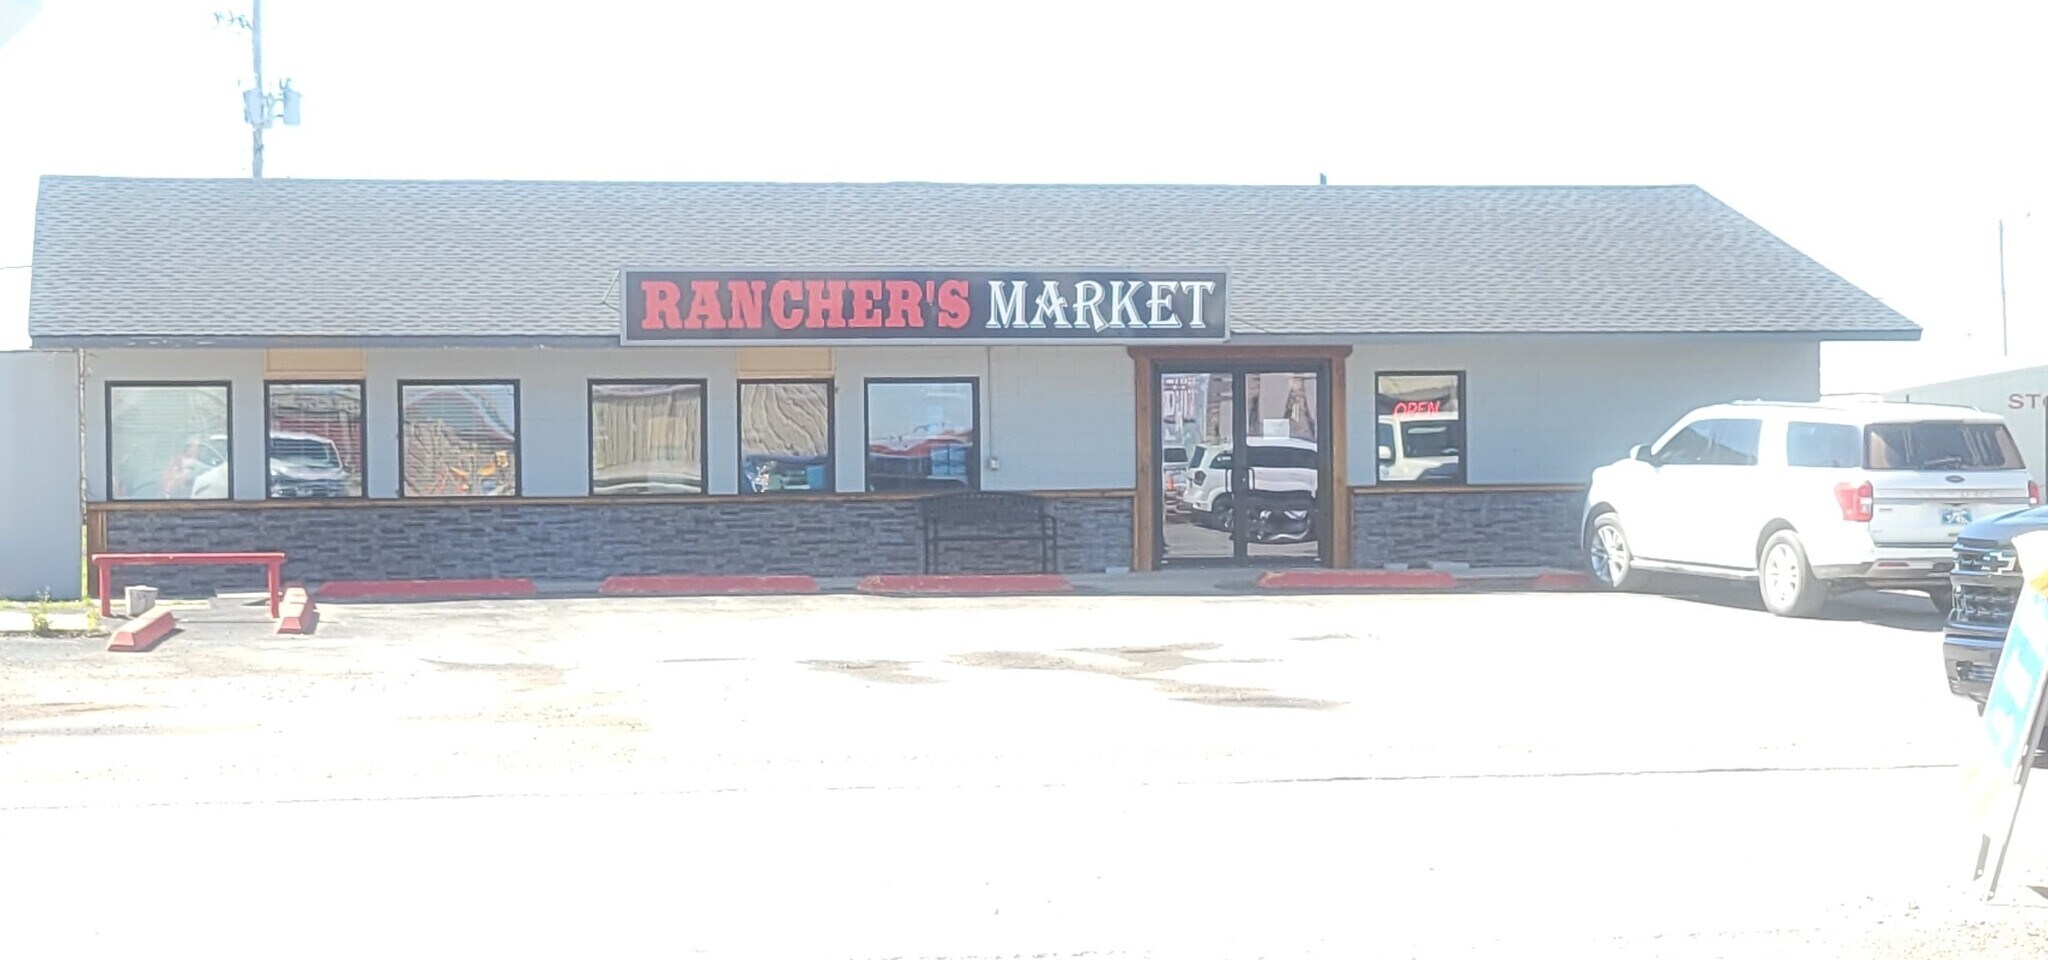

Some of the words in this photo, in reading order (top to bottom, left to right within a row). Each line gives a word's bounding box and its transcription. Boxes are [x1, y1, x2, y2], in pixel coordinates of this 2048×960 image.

[641, 279, 971, 330] RANCHER'S
[985, 280, 1216, 333] MARKET
[1393, 400, 1441, 417] OPEN
[2008, 393, 2048, 410] ST
